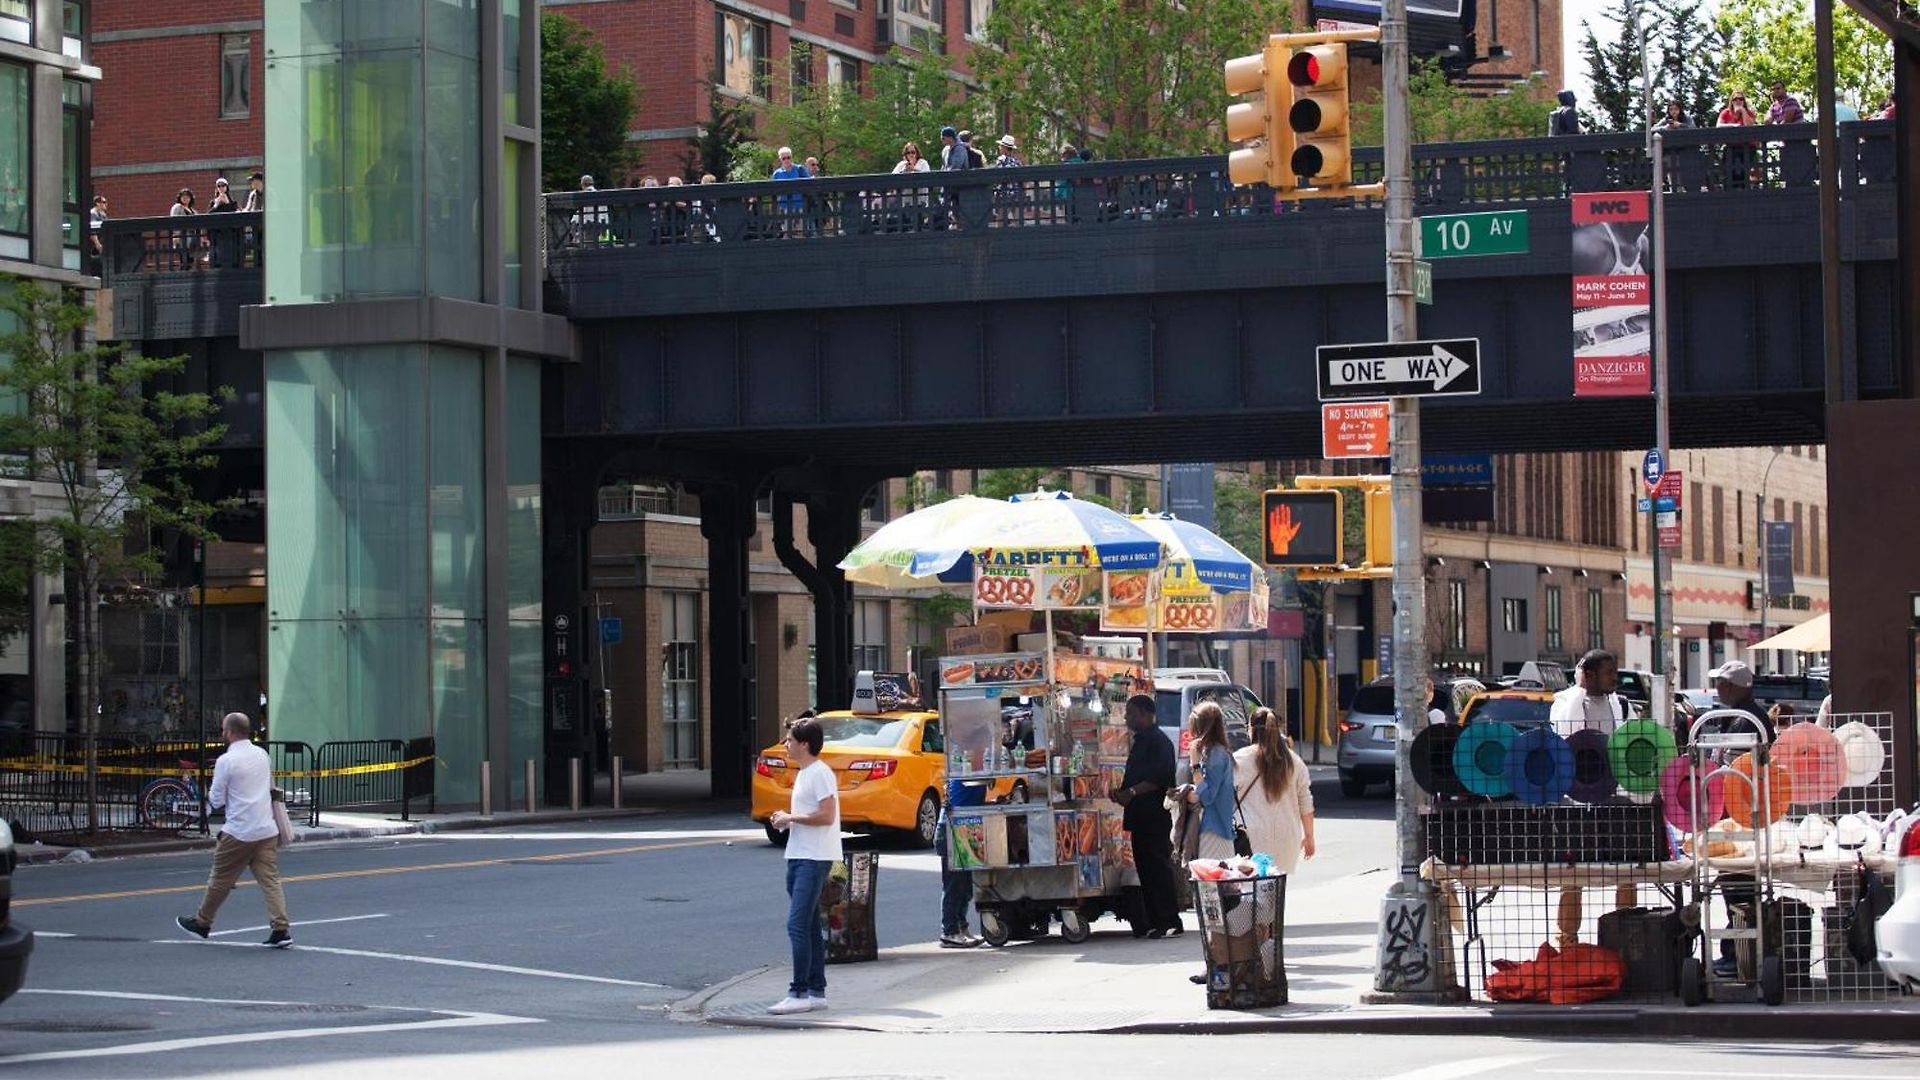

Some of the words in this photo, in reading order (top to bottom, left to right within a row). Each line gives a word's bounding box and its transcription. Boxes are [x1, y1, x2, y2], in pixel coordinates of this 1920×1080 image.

[1591, 201, 1630, 214] NYC
[1437, 220, 1470, 250] 10
[1576, 283, 1606, 291] MARK
[1609, 282, 1646, 290] COHEN
[1577, 293, 1592, 301] May
[1342, 361, 1386, 382] ONE
[1407, 358, 1453, 379] WAY
[1579, 362, 1646, 373] DANZIGER
[1329, 409, 1341, 420] NO
[1344, 408, 1384, 419] STANDING
[983, 568, 1030, 576] PRETZEL
[1170, 595, 1214, 603] PRETZEL
